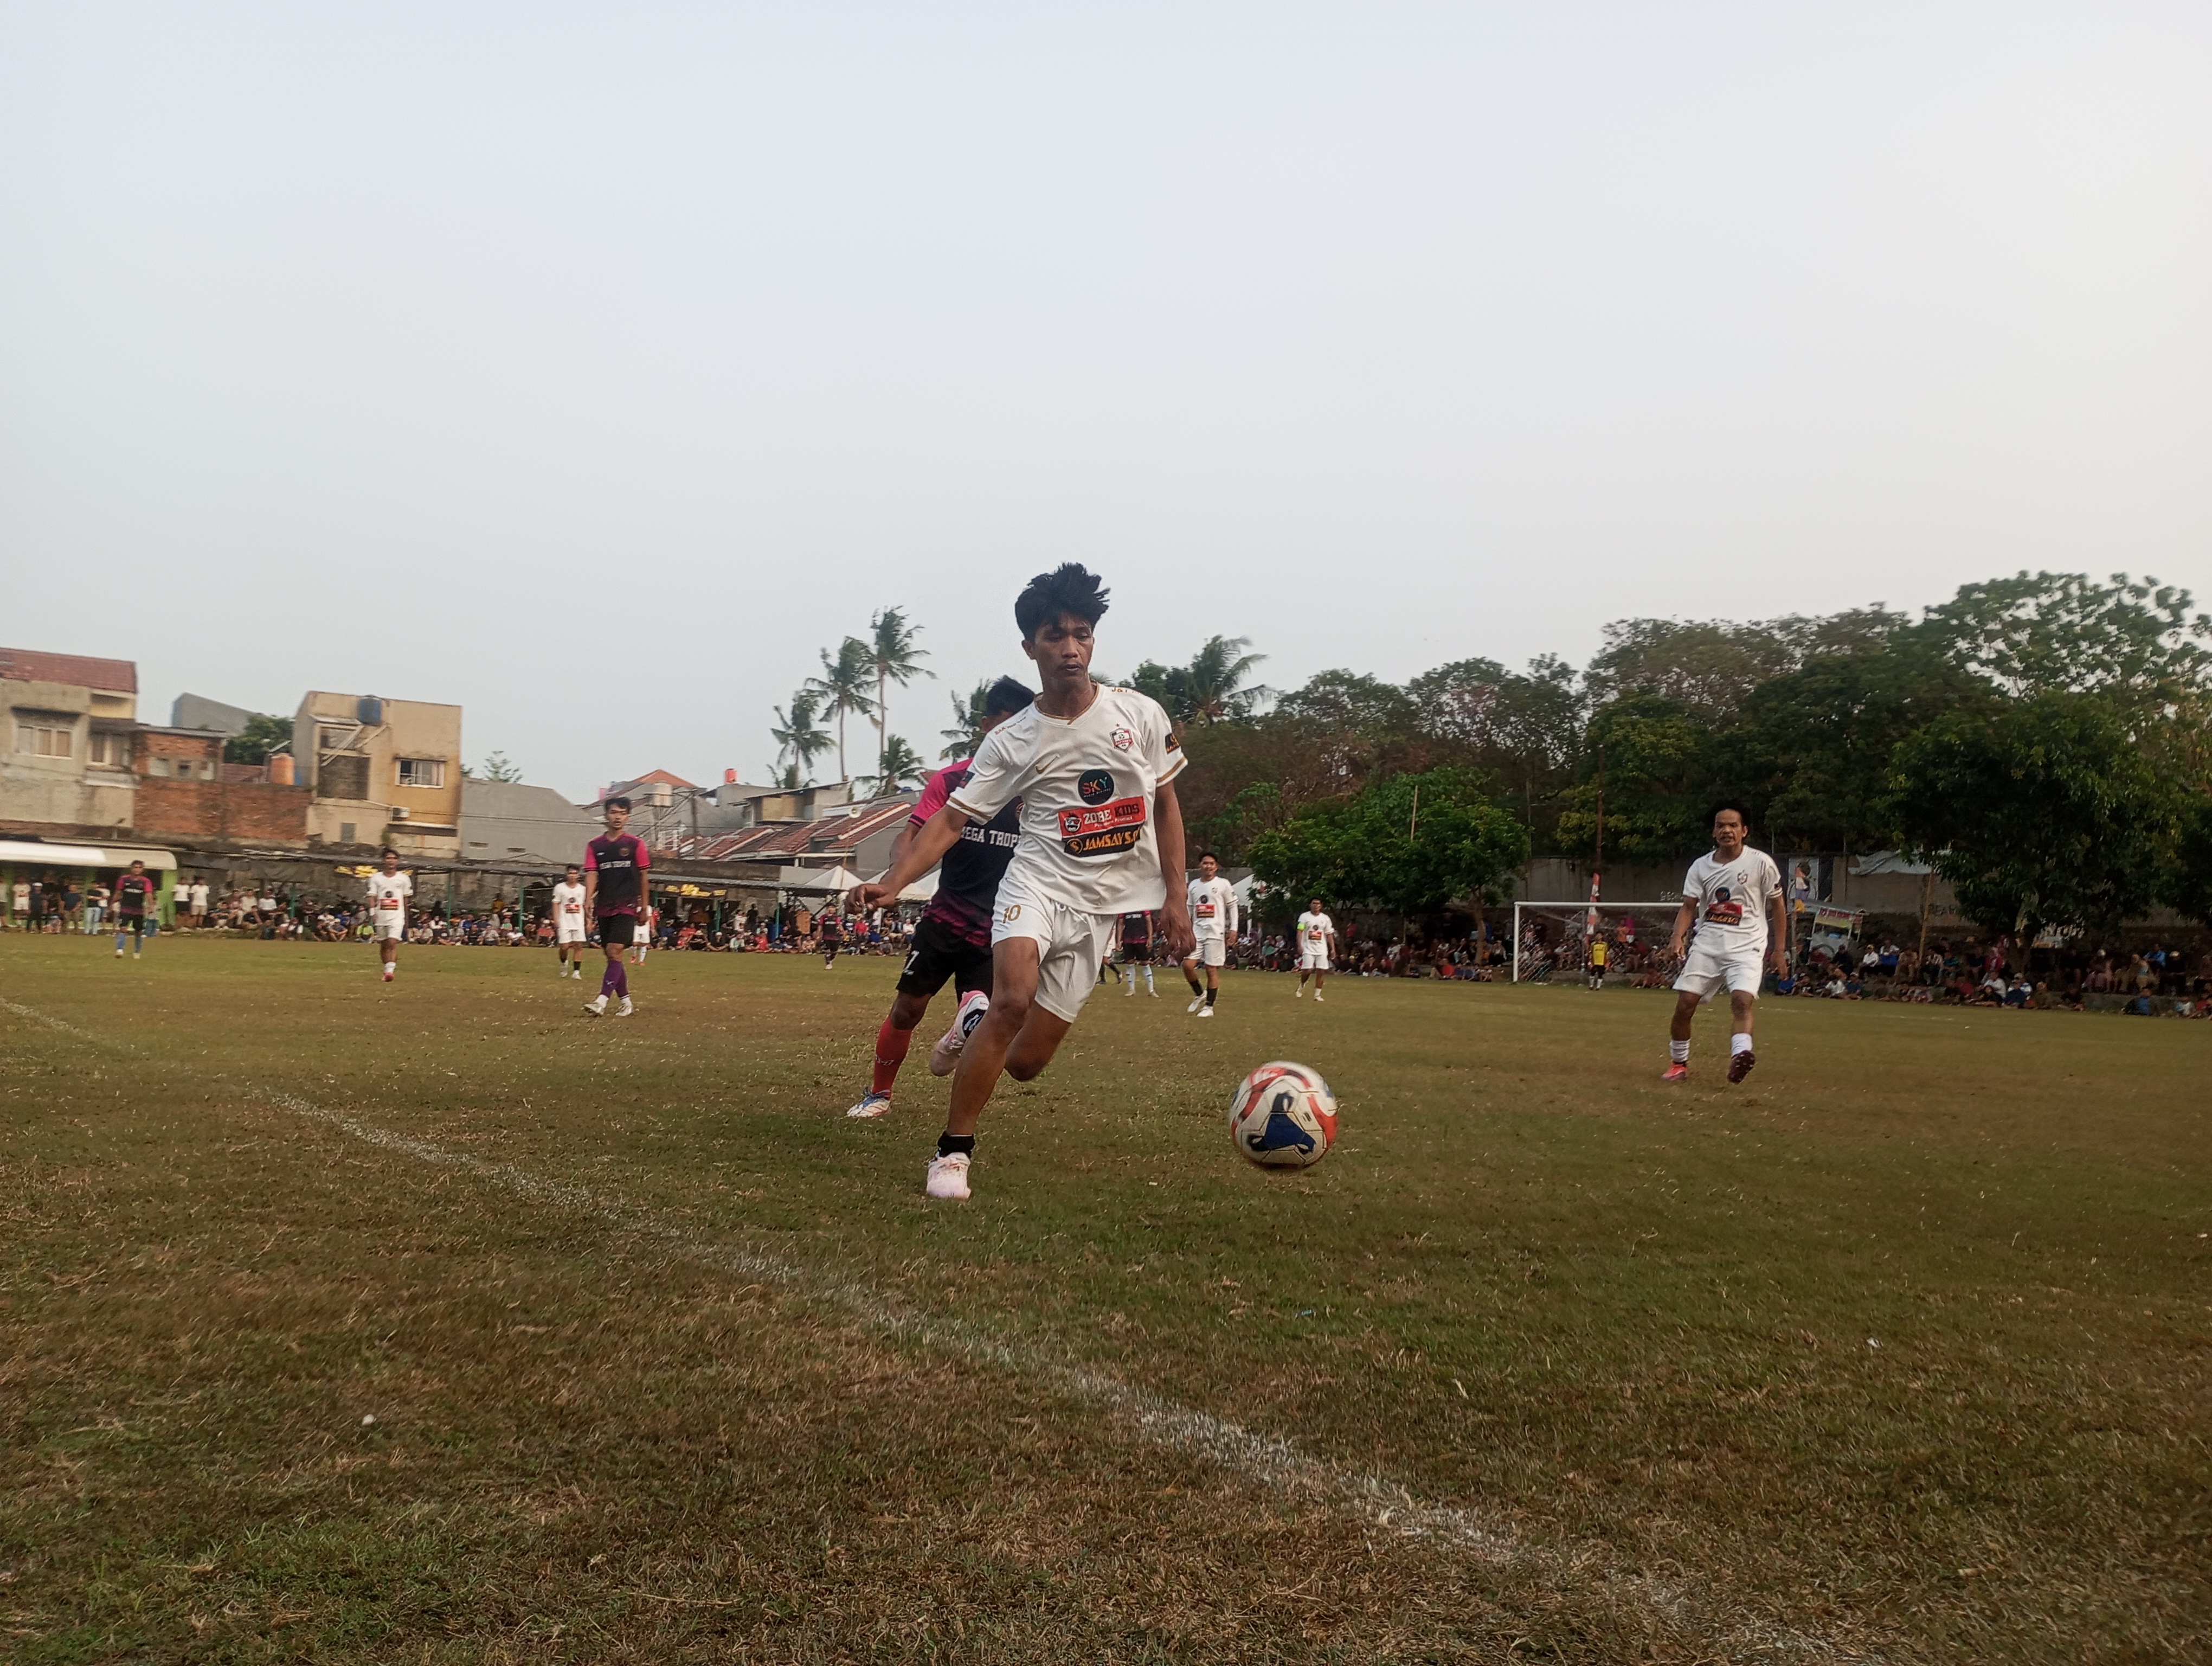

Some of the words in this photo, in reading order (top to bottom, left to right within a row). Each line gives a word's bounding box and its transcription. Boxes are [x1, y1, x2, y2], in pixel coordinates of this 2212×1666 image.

[1082, 777, 1107, 794] SKY
[1083, 809, 1112, 824] ZOBE
[1114, 803, 1140, 817] KIDS
[989, 830, 1021, 848] TROP
[1083, 832, 1124, 850] JAMSAY
[1003, 905, 1021, 924] 10
